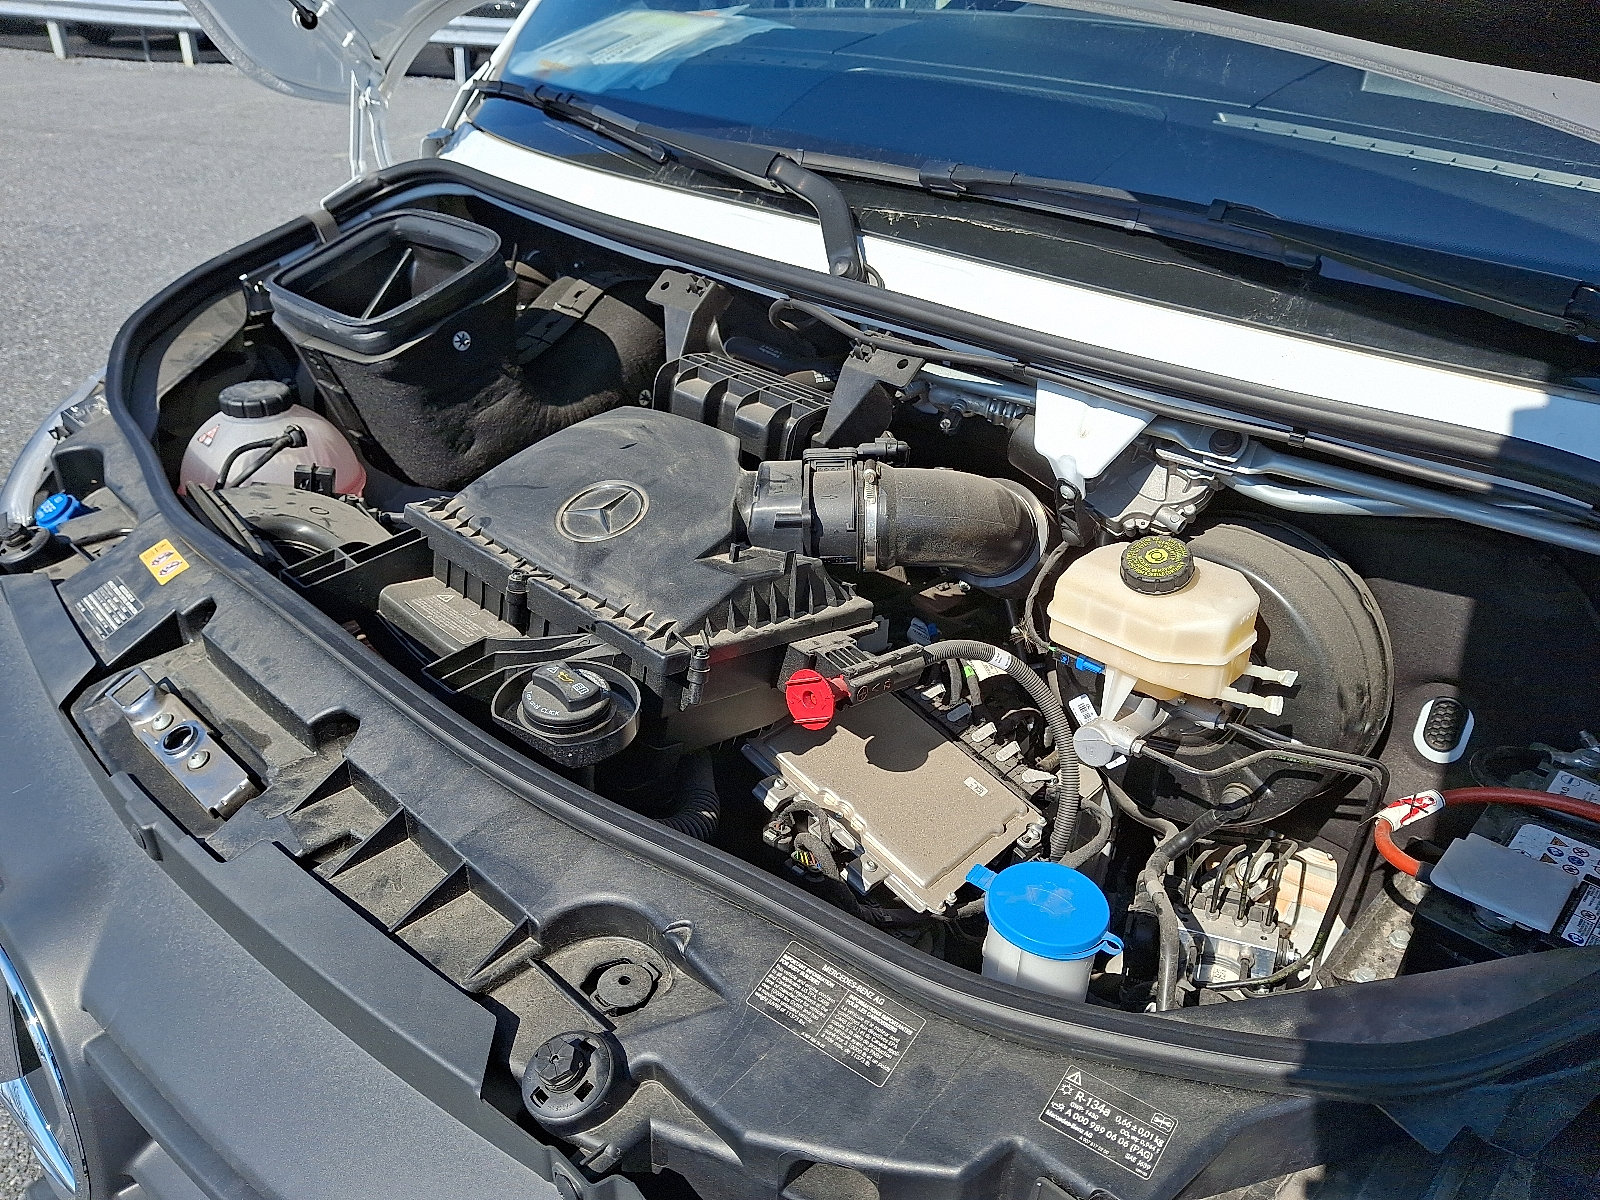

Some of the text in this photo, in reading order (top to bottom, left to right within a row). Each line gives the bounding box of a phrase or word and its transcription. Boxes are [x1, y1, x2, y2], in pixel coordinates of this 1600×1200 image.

[541, 707, 560, 715] CLICK
[783, 954, 835, 988] IMPORTANT INFORMATION
[788, 964, 801, 973] BODY
[822, 965, 874, 999] MERCEDES-BENZ
[846, 999, 859, 1009] POUR
[1074, 1091, 1111, 1116] R-134a
[1115, 1116, 1132, 1128] 0,66
[1138, 1127, 1154, 1140] 0,01
[1154, 1136, 1164, 1147] kg
[1085, 1110, 1099, 1120] 1430
[1046, 1110, 1084, 1133] Mercedes-Benz
[1125, 1153, 1137, 1162] SAE
[1137, 1160, 1151, 1170] J639
[1073, 1113, 1089, 1125] 000
[1089, 1122, 1105, 1133] 989
[1106, 1131, 1117, 1140] 06
[1117, 1138, 1129, 1147] 06
[1130, 1144, 1153, 1162] (PAG)
